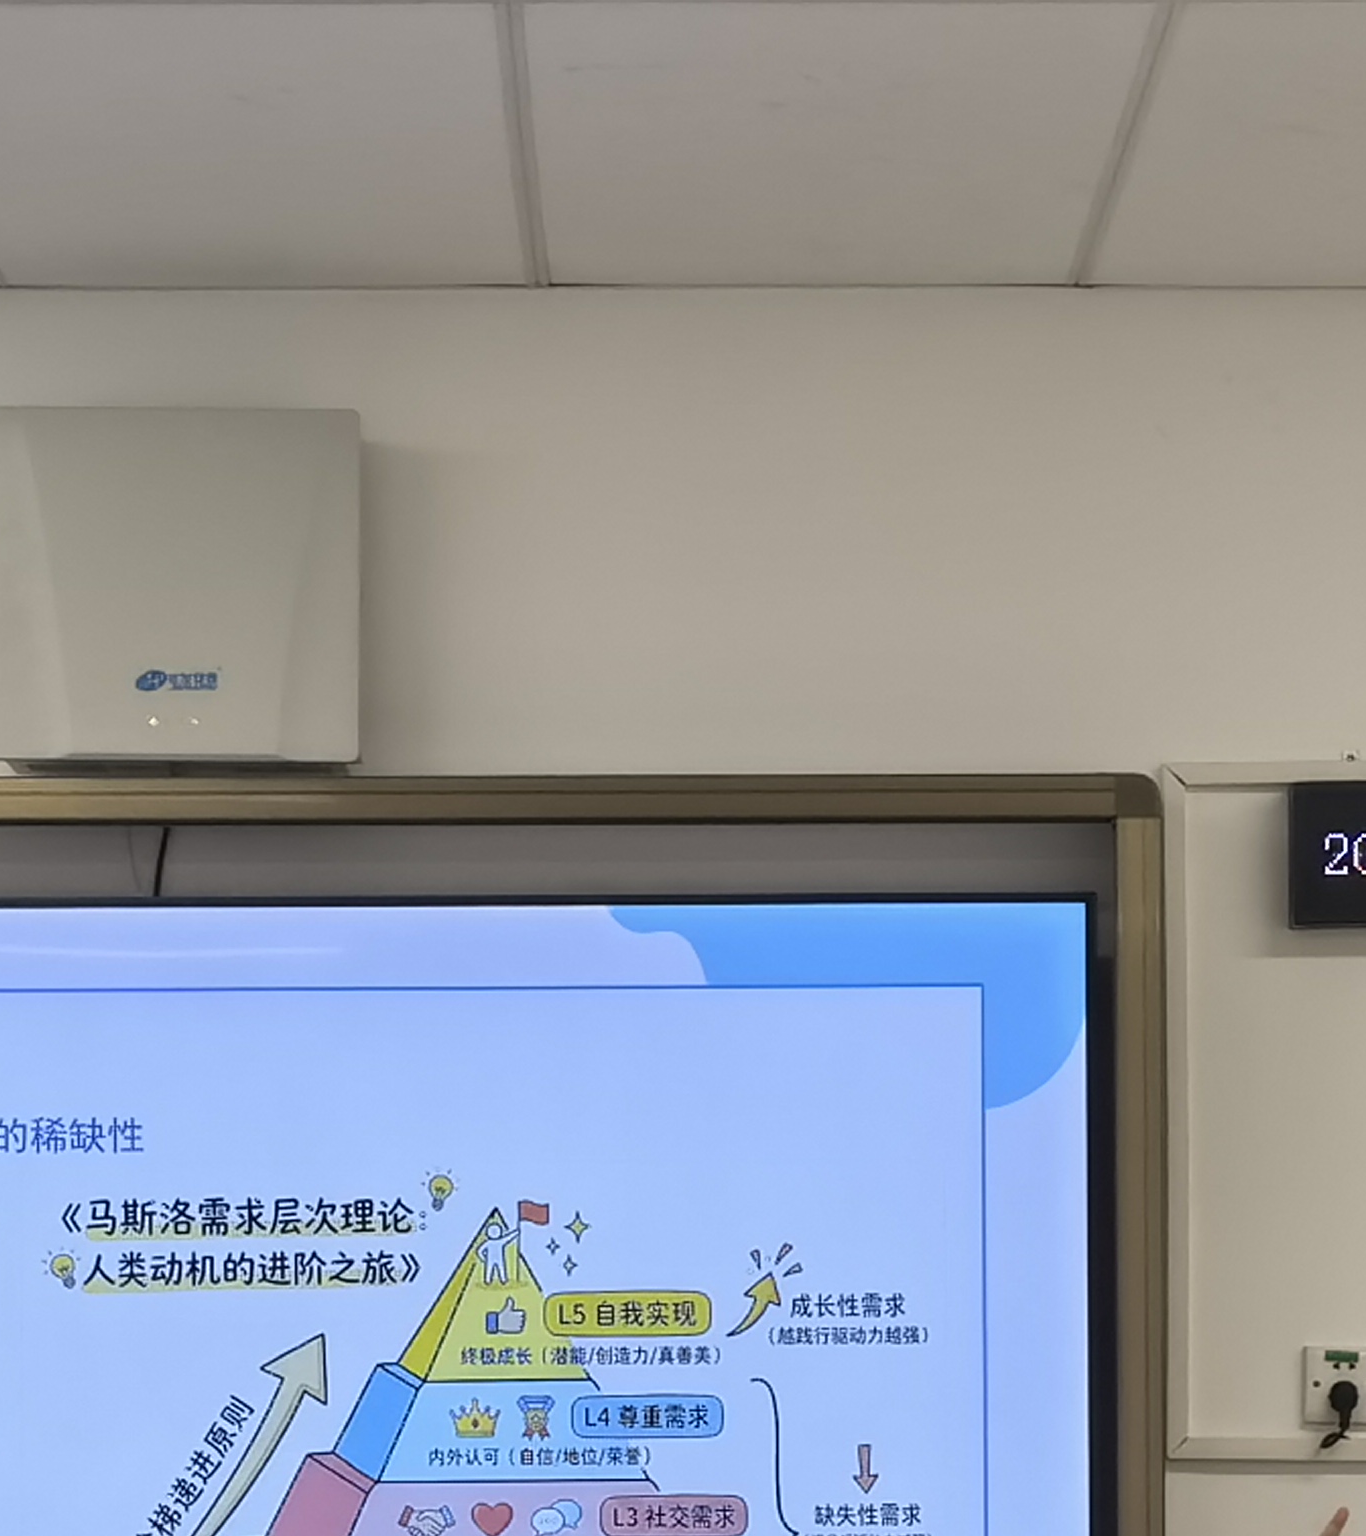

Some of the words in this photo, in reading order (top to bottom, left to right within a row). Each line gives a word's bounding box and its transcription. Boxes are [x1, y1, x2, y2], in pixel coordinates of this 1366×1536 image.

[83, 1249, 422, 1287] 人类动机的进阶之旅》
[558, 1302, 587, 1326] L5
[596, 1299, 698, 1327] 自我实现
[790, 1292, 907, 1318] 成长性需求
[584, 1406, 611, 1428] L4
[618, 1403, 710, 1430] 尊重需求
[613, 1506, 639, 1528] L3
[645, 1503, 736, 1529] 社交需求
[814, 1502, 923, 1527] 缺失性需求
